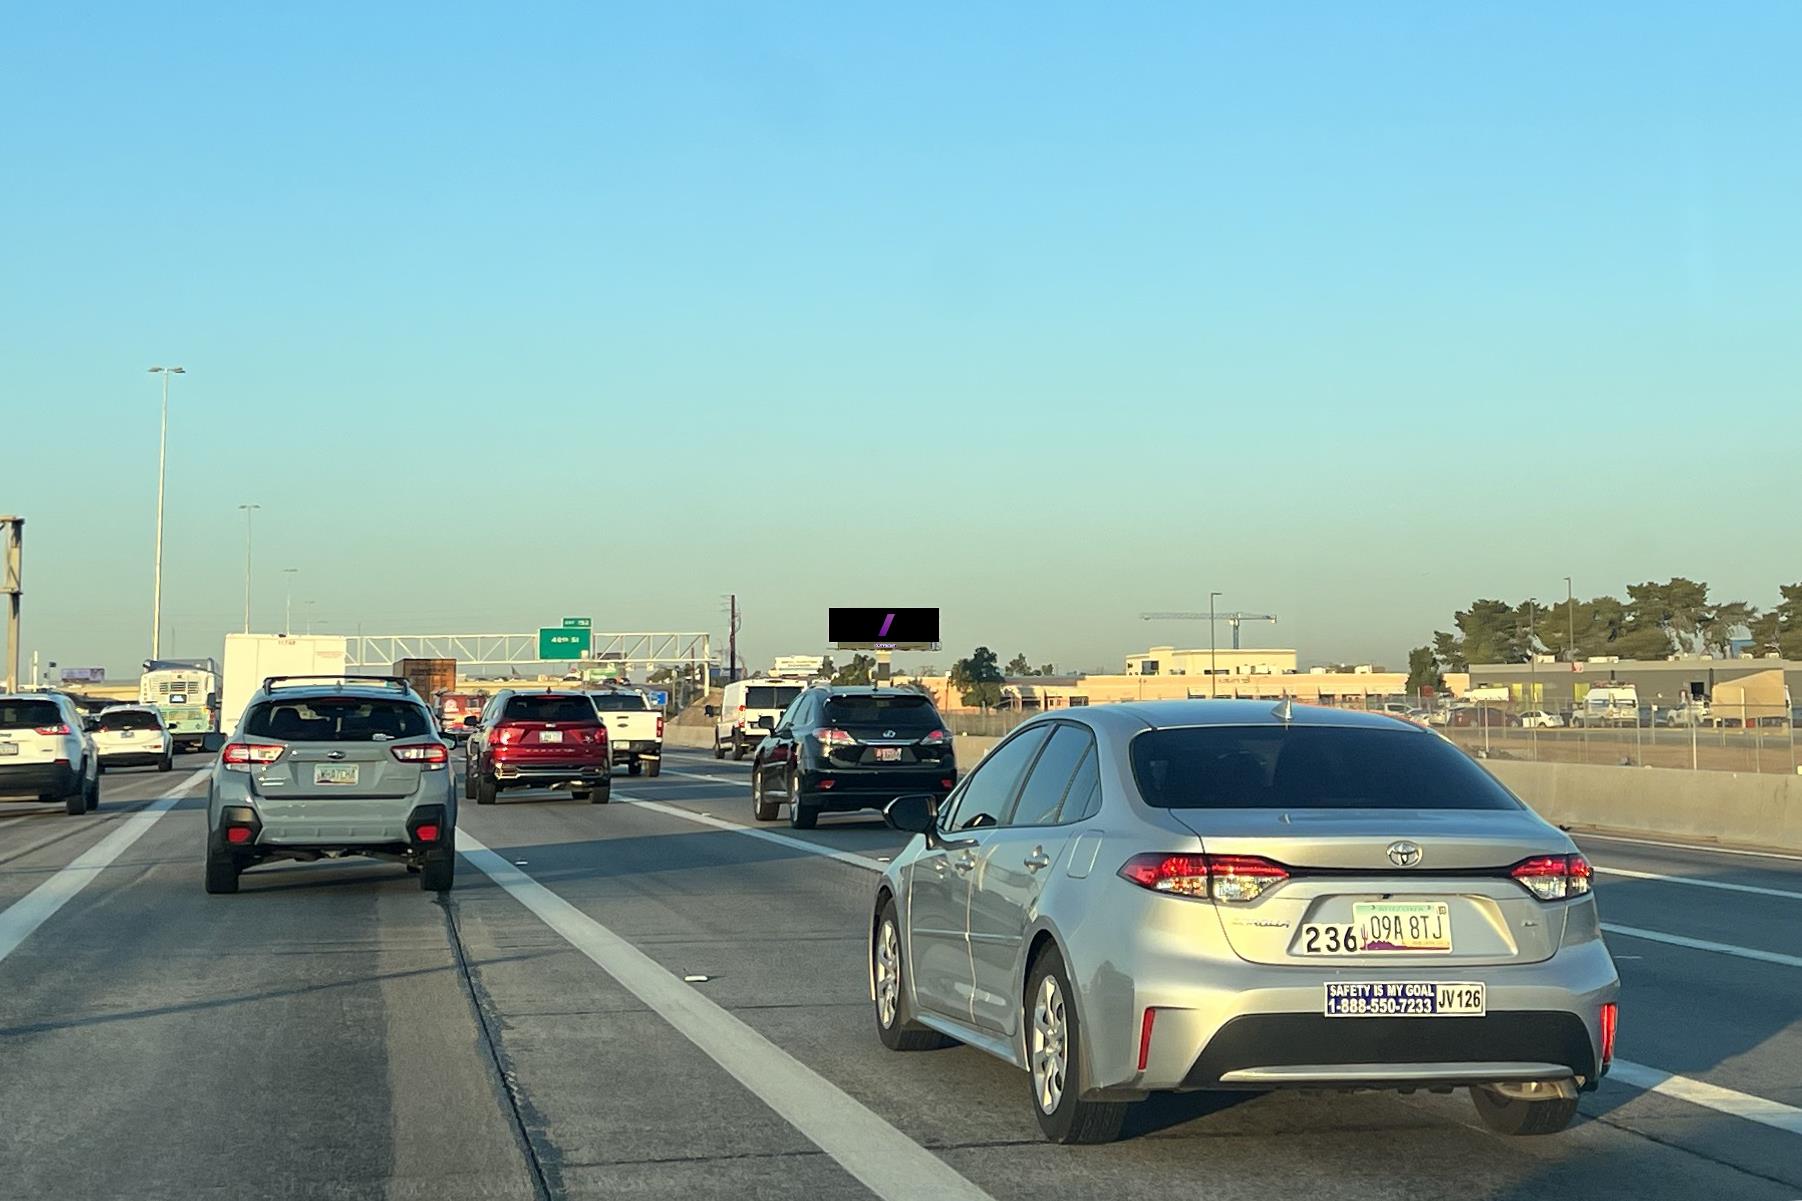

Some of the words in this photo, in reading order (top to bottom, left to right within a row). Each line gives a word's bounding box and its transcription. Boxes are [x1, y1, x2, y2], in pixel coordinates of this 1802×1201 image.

[1409, 915, 1443, 940] 8TJ
[1305, 926, 1358, 952] 236
[1329, 984, 1371, 997] SAFETY
[1373, 984, 1385, 997] IS
[1387, 984, 1404, 997] MY
[1405, 984, 1435, 997] GOAL
[1328, 998, 1432, 1014] 1-888-550-7233
